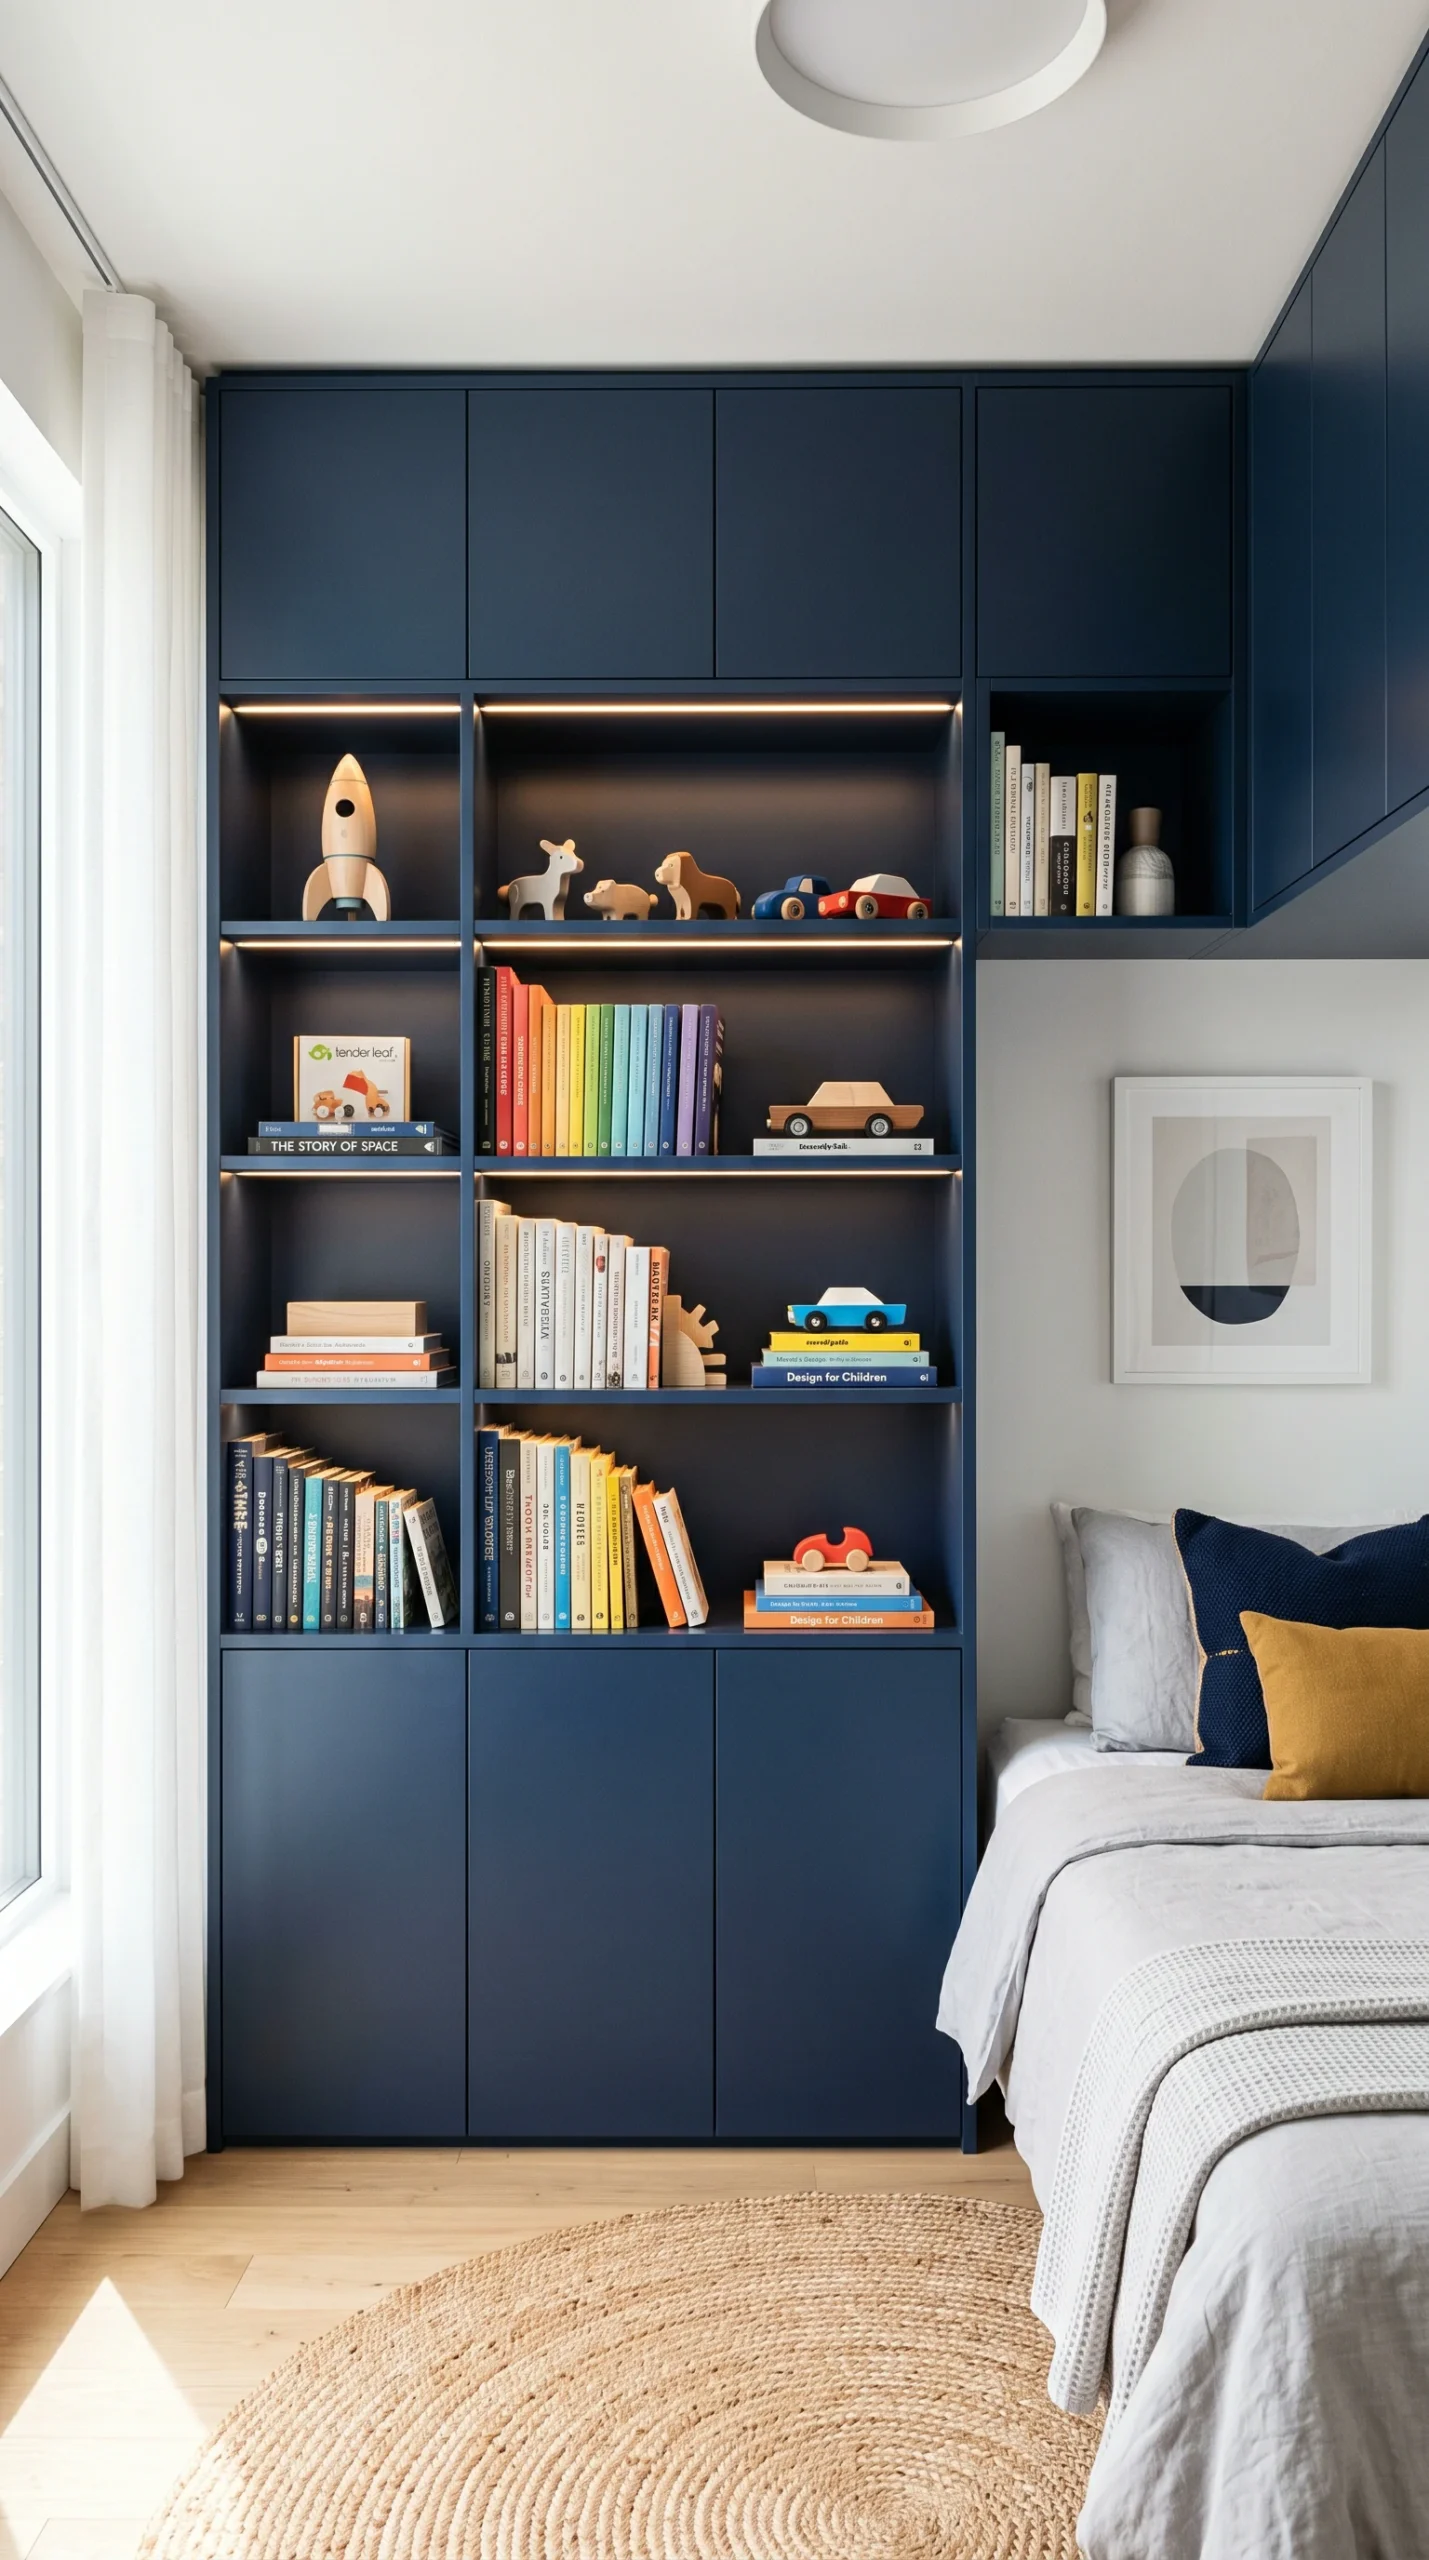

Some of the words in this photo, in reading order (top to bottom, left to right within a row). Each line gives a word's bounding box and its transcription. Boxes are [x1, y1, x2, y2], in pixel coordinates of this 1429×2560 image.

[335, 1046, 370, 1058] tender
[372, 1046, 394, 1058] leaf
[271, 1141, 294, 1152] THE
[298, 1141, 337, 1152] STORY
[340, 1141, 358, 1152] OF
[361, 1141, 398, 1152] SPACE
[787, 1372, 822, 1385] Design
[825, 1372, 840, 1382] for
[825, 1615, 839, 1625] for
[841, 1615, 884, 1625] Children
